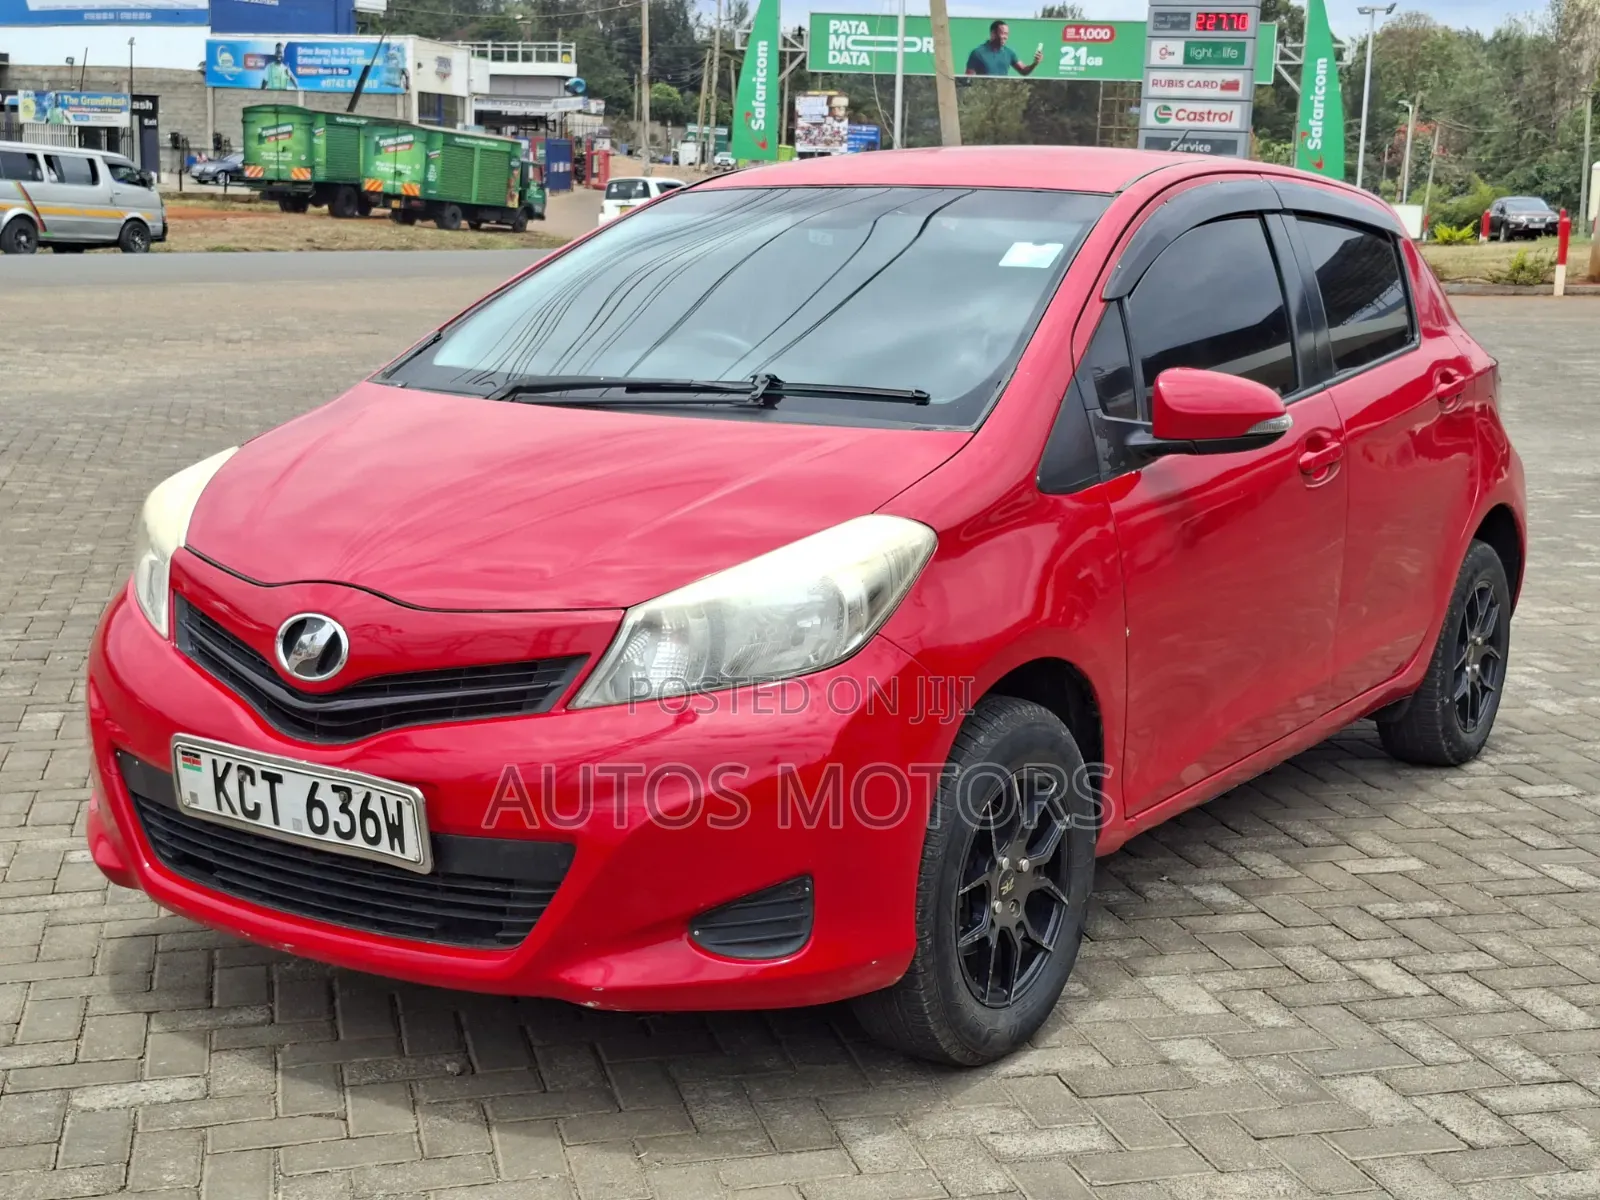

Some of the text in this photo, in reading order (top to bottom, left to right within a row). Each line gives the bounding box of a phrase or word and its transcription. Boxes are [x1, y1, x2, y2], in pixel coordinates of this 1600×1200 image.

[828, 19, 870, 35] PATA
[1079, 27, 1111, 40] 1,000
[828, 50, 871, 66] DATA
[1190, 47, 1213, 60] light
[1222, 47, 1239, 59] life
[751, 40, 769, 131] Safaricom
[1187, 79, 1219, 90] CARD
[64, 95, 79, 105] The
[132, 100, 153, 110] ash
[1307, 57, 1328, 150] Safaricom
[1175, 108, 1234, 123] Castrol
[1170, 140, 1212, 152] Service
[211, 757, 406, 855] KCT 636W
